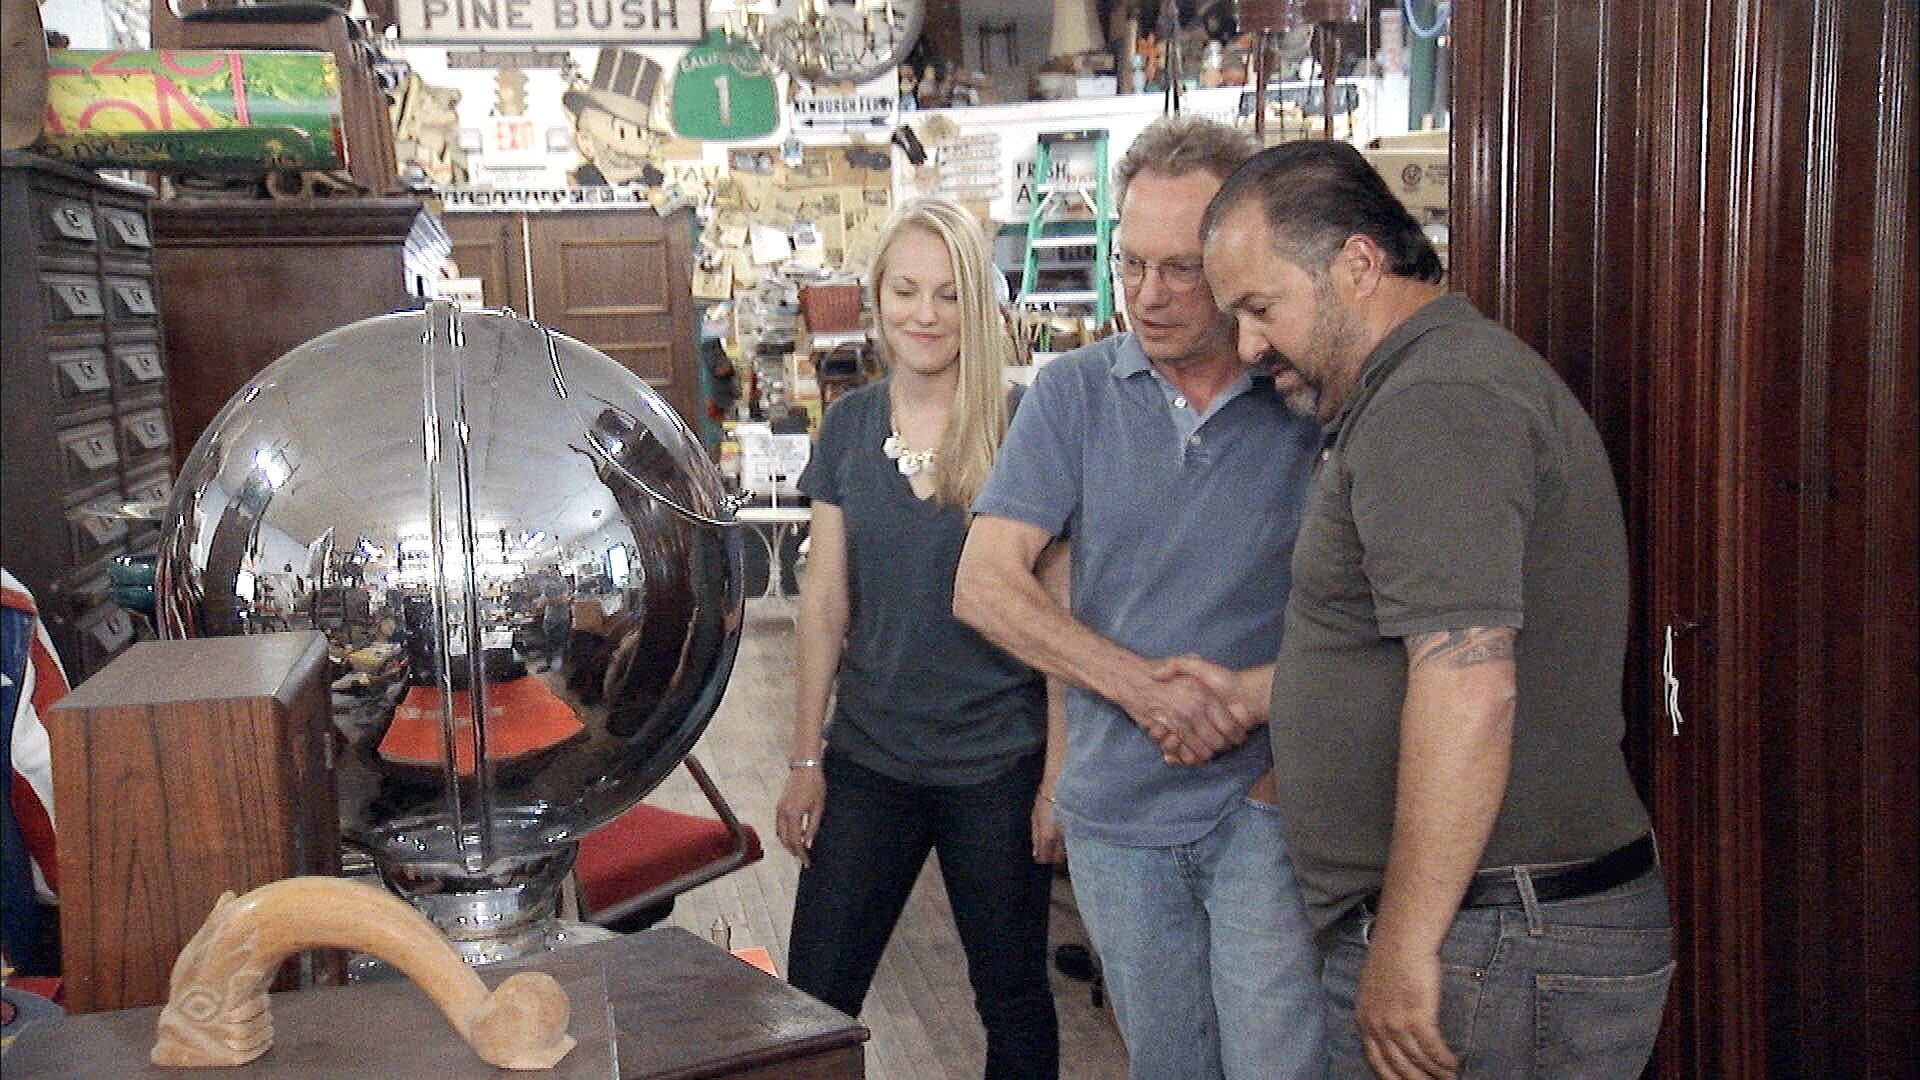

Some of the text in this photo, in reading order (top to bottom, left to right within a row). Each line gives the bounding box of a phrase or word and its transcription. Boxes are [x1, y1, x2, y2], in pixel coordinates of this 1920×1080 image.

[423, 0, 679, 29] PINE BUSH
[714, 75, 730, 128] 1
[794, 98, 856, 113] NEWBURGH
[496, 121, 535, 151] EXIT
[1017, 162, 1066, 179] FRSH
